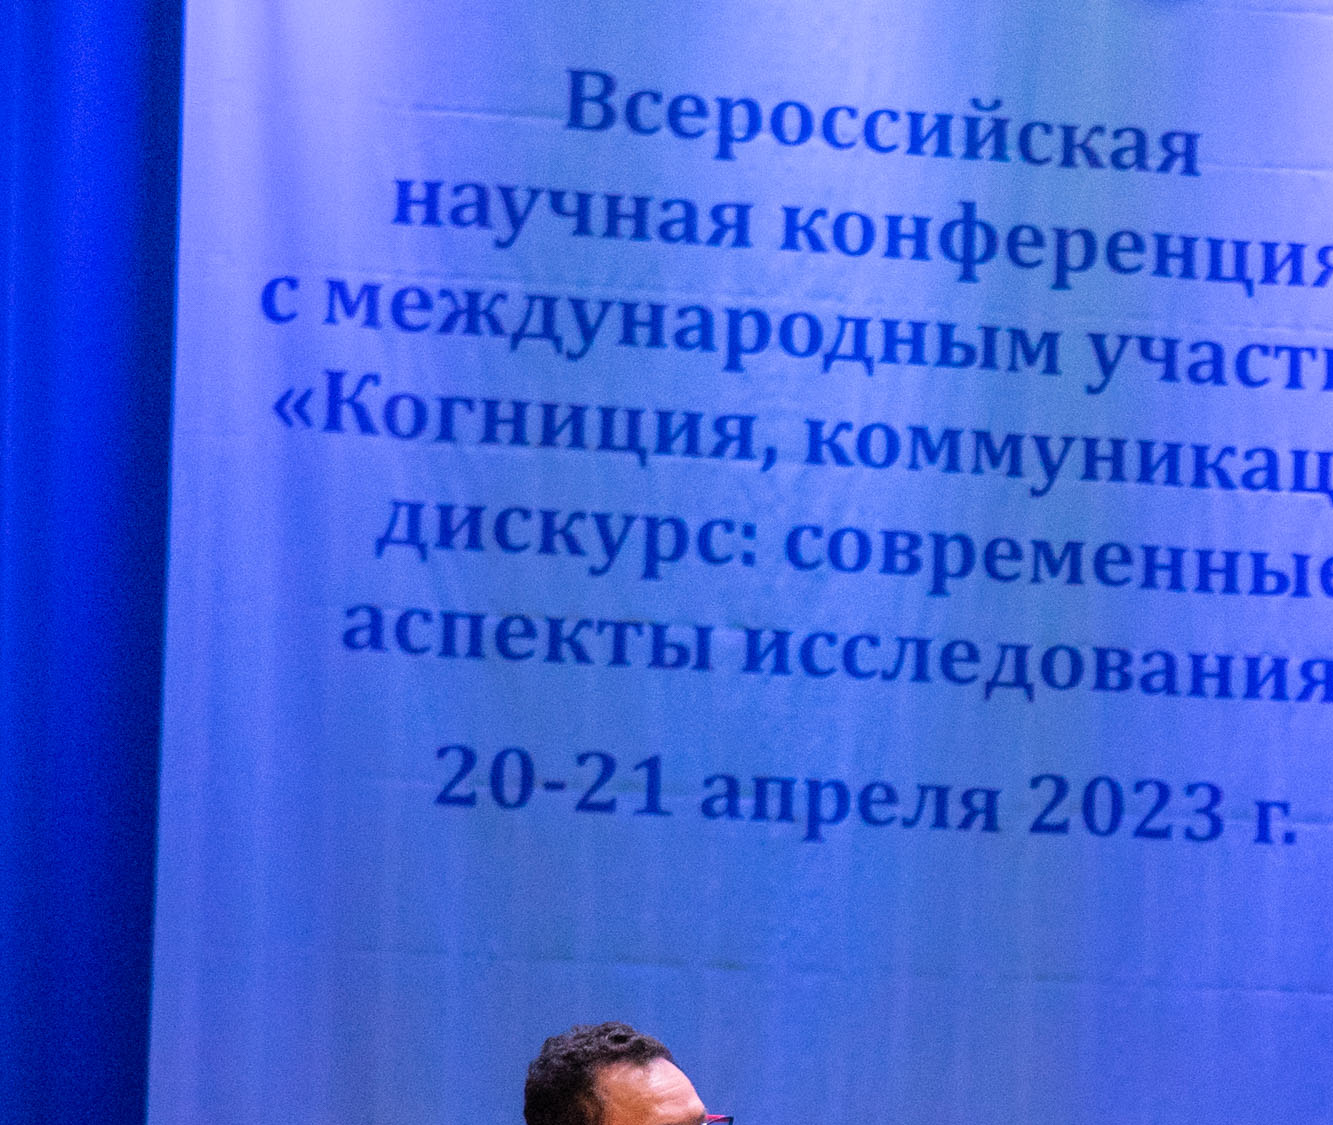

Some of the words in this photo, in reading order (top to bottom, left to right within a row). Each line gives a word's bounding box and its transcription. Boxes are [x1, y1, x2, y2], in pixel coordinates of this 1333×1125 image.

[565, 68, 1200, 178] Всероссийская
[392, 178, 752, 251] научная
[259, 274, 300, 326] с
[324, 278, 1061, 376] международным
[272, 369, 779, 473] «Когниция,
[374, 499, 757, 581] дискурс:
[340, 603, 713, 673] аспекты
[434, 743, 671, 817] 20-21
[699, 772, 1001, 843] апреля
[1029, 773, 1225, 844] 2023
[1253, 799, 1297, 846] г.
